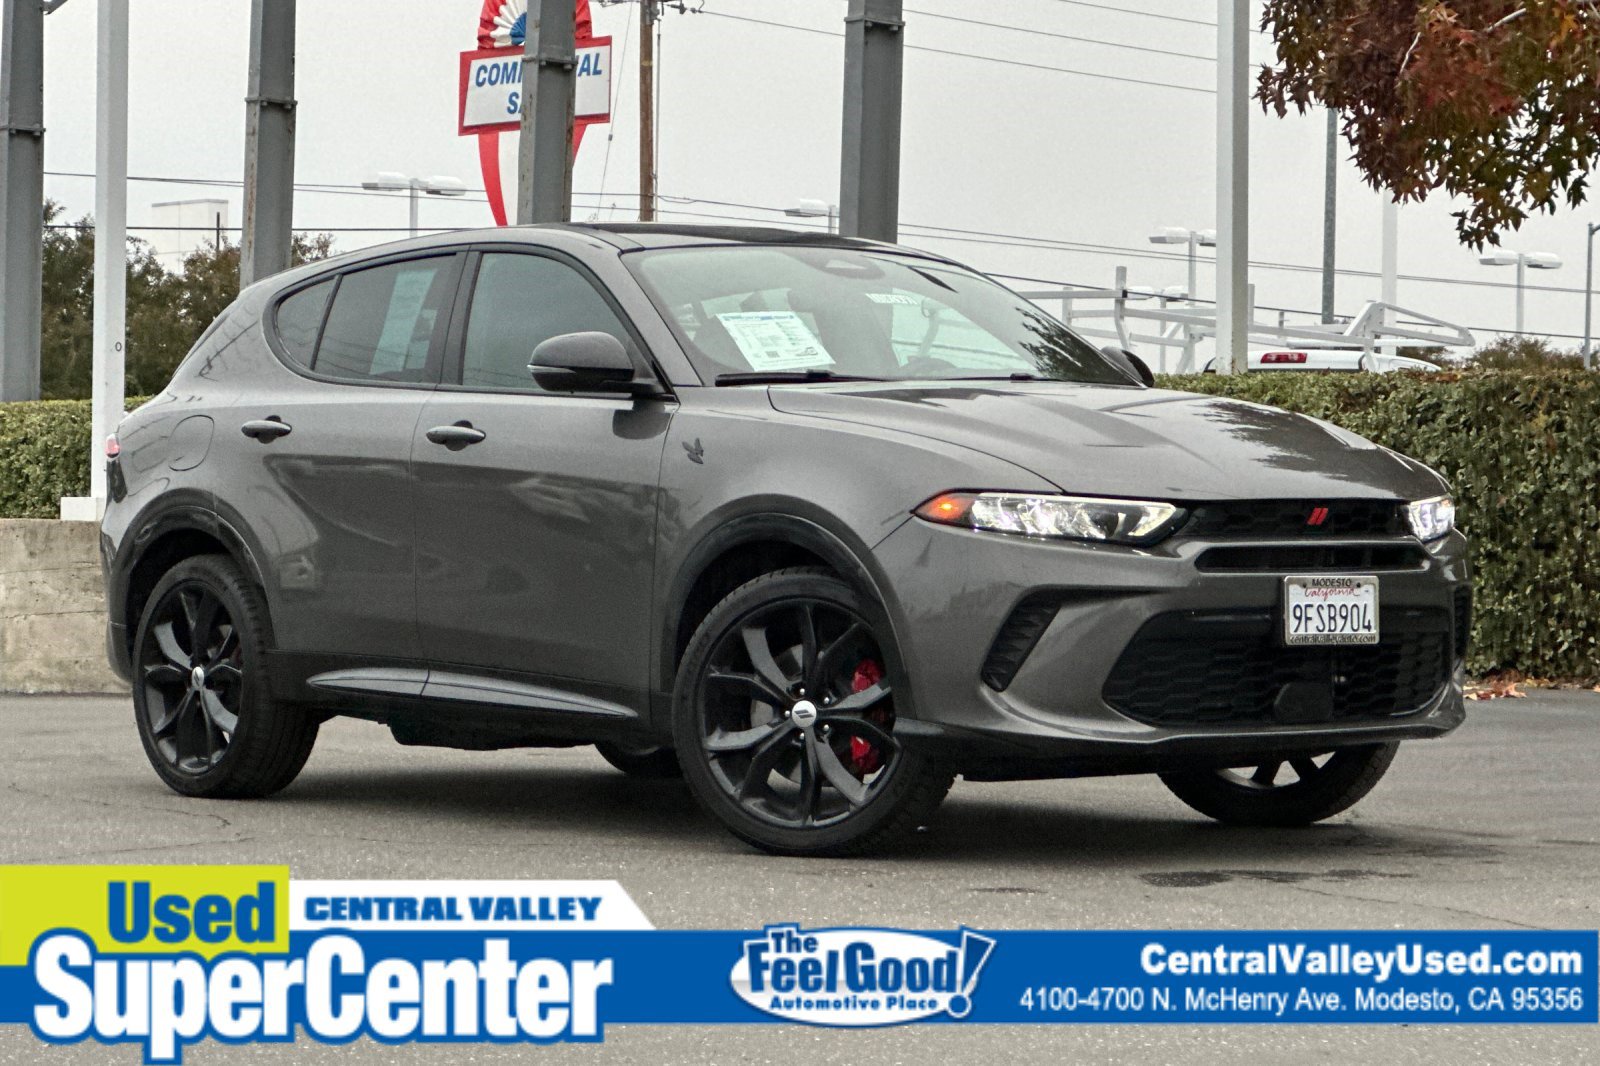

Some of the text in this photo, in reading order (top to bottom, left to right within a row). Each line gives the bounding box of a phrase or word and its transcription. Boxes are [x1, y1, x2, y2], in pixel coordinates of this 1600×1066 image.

[475, 53, 602, 88] COMAL
[1312, 578, 1352, 587] MODESTO
[1305, 587, 1360, 601] California
[1293, 603, 1372, 632] 9FSB904
